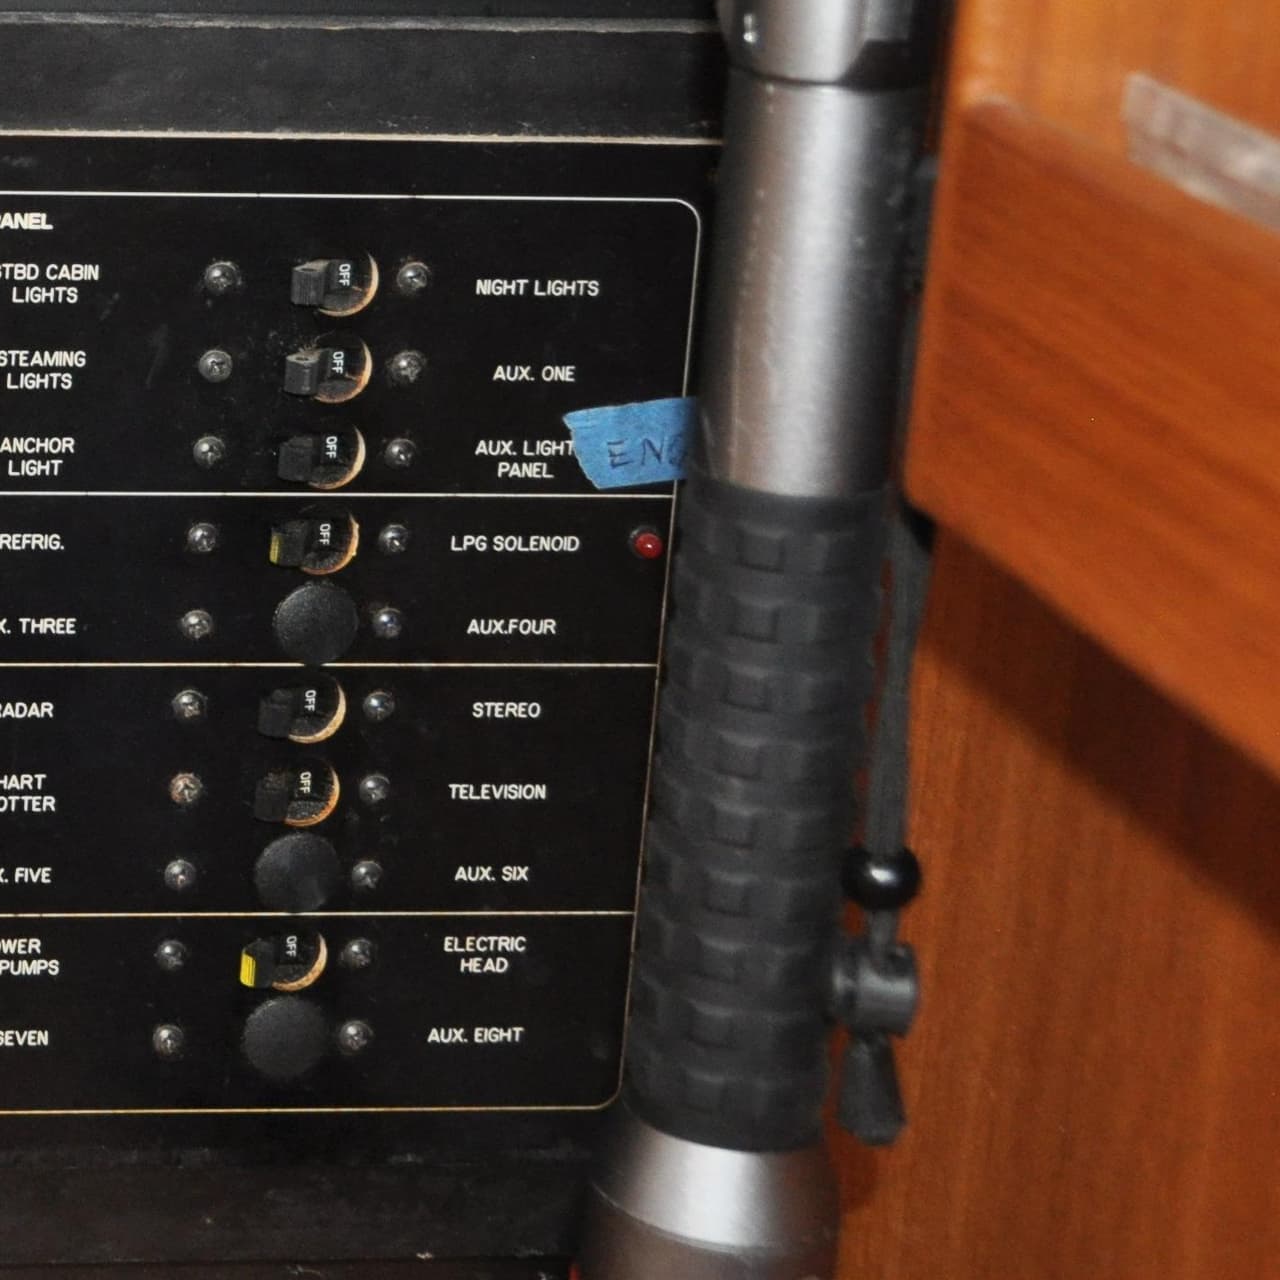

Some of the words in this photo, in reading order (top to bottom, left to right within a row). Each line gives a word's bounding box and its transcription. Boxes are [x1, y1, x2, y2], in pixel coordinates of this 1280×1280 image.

[45, 263, 100, 281] CABIN
[11, 286, 79, 304] LIGHTS
[450, 534, 488, 552] LPG
[492, 535, 580, 552] SOLENOID
[472, 701, 541, 719] STEREO
[448, 783, 547, 800] TELEVISION
[443, 935, 527, 953] ELECTRIC
